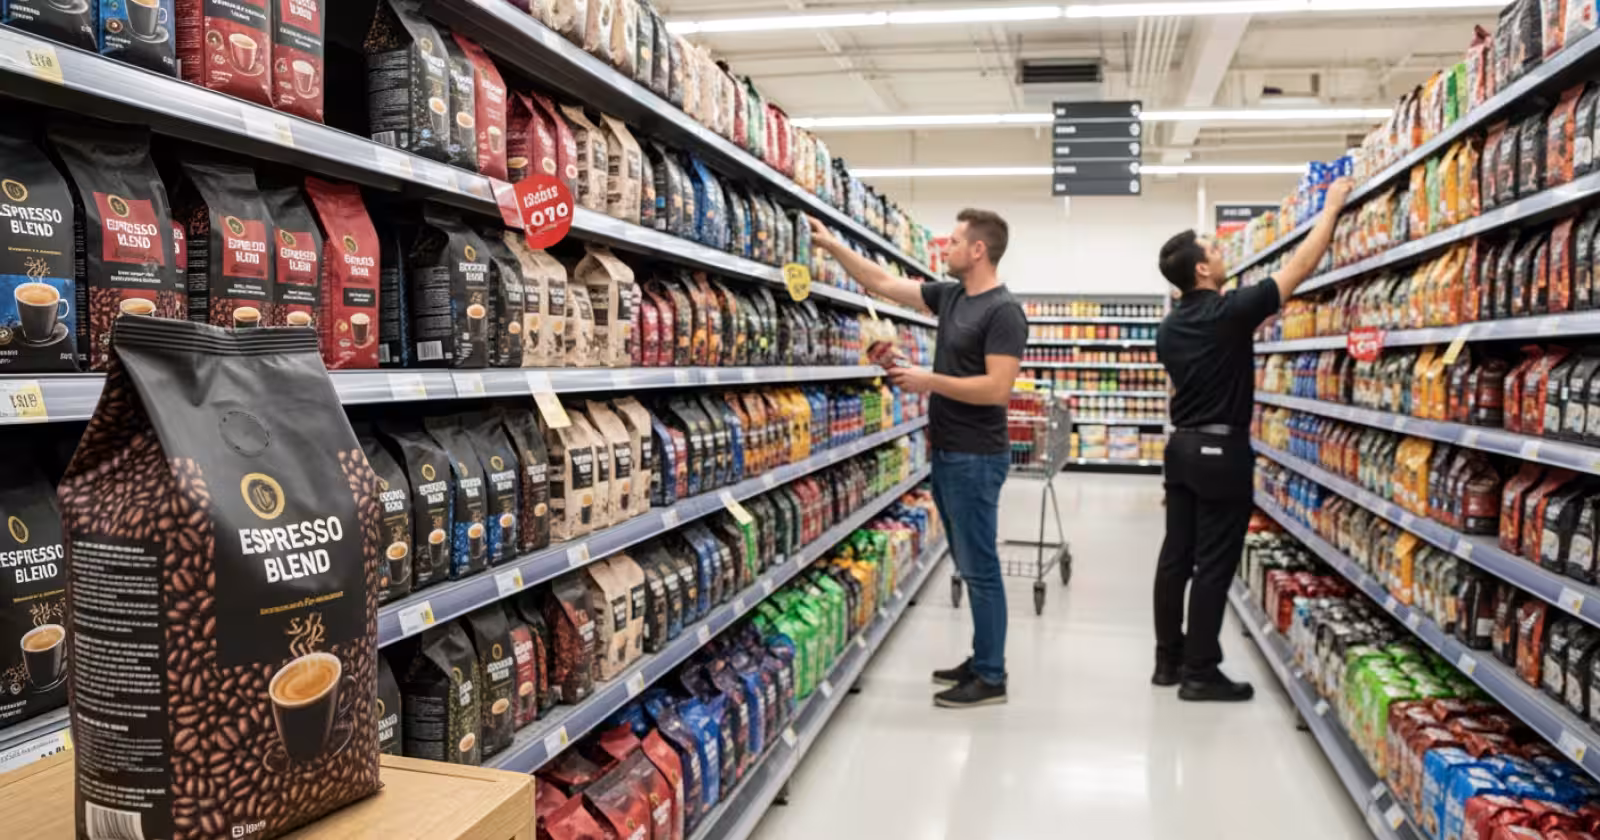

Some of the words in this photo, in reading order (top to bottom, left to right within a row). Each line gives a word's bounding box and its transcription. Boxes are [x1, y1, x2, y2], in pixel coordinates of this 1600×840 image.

[0, 203, 62, 223] SPRESSO
[10, 220, 53, 237] BLEND
[238, 516, 343, 555] ESPRESSO
[15, 563, 57, 583] BLEND
[264, 549, 331, 583] BLEND
